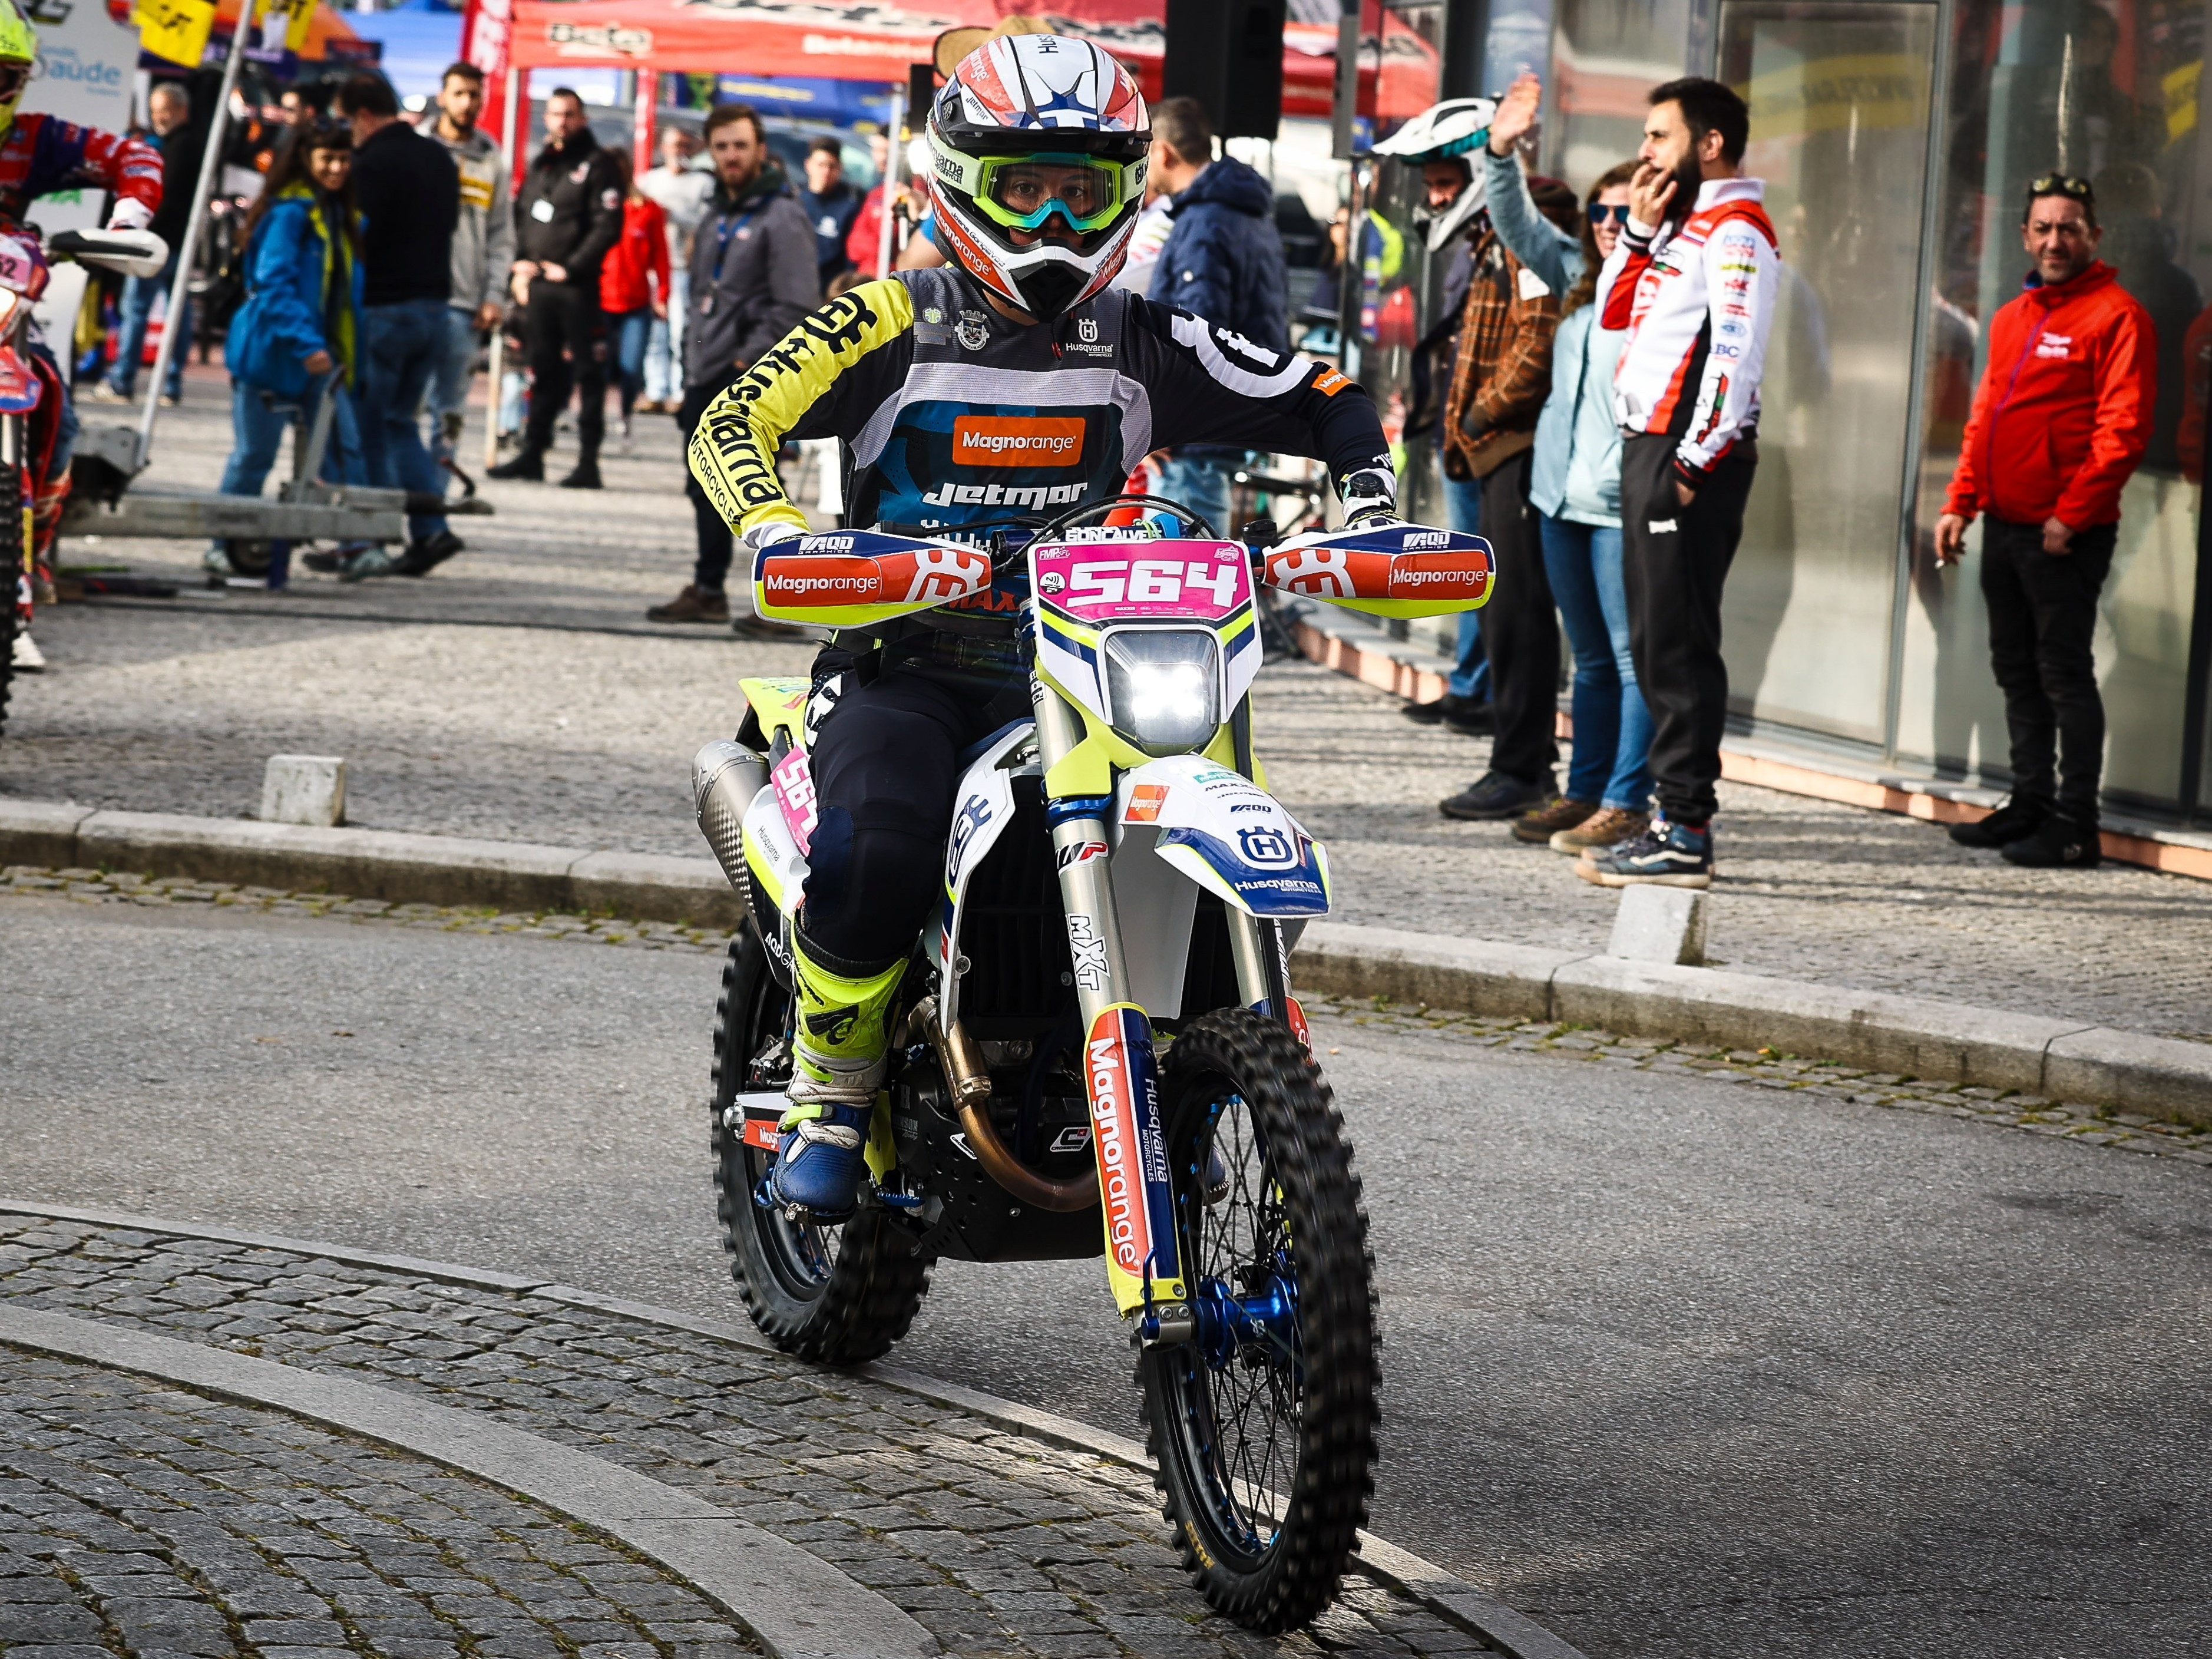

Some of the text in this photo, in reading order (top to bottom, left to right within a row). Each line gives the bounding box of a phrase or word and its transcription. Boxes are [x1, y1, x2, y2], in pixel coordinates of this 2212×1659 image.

[1066, 343, 1112, 353] Husqvarna
[963, 431, 1076, 452] Magnorange
[1039, 548, 1060, 558] FMP
[766, 574, 880, 594] Magnorange
[1066, 560, 1238, 608] 564
[1393, 568, 1484, 584] Magnorange
[758, 825, 780, 862] Husqvarna
[1234, 880, 1318, 891] Husqvarna
[1145, 1078, 1168, 1183] Husqvarna
[1089, 1037, 1137, 1265] Magnorange
[1142, 1129, 1155, 1182] MOTORCYCLES
